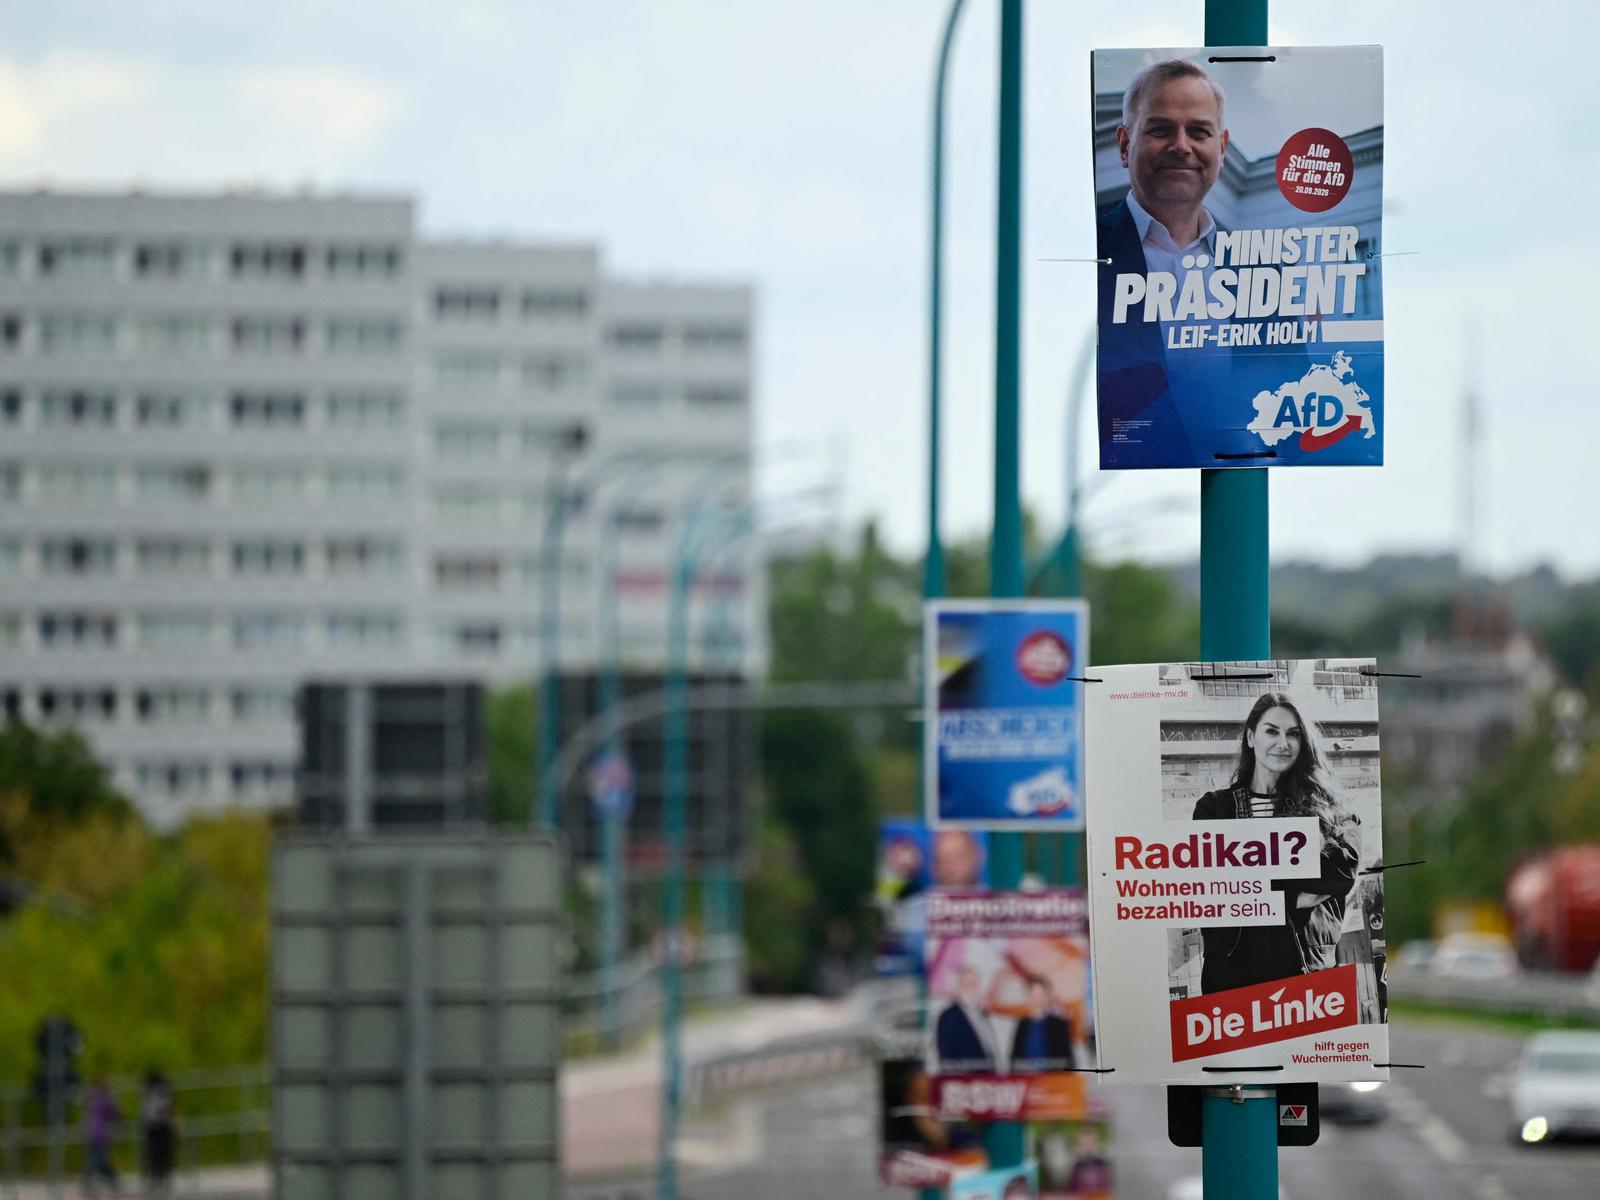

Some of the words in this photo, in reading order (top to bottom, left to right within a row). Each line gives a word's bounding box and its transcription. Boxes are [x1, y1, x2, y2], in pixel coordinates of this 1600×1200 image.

[1307, 143, 1331, 159] Alle
[1288, 154, 1341, 173] Stimmen
[1282, 168, 1301, 183] für
[1303, 169, 1321, 185] die
[1323, 171, 1346, 187] AfD
[1214, 225, 1360, 267] MINISTER
[1112, 253, 1366, 324] PRÄSIDENT
[1167, 322, 1263, 349] LEIF-ERIK
[1266, 320, 1319, 345] HOLM
[1273, 391, 1344, 428] AfD
[1109, 689, 1189, 701] www.dielinke-mv.de
[1114, 830, 1308, 871] Radikal?
[1116, 879, 1206, 898] Wohnen
[1210, 879, 1263, 896] muss
[1117, 900, 1226, 921] bezahlbar
[1230, 898, 1277, 918] sein.
[1186, 1007, 1245, 1046] Die
[1251, 985, 1345, 1033] Linke
[1291, 1052, 1372, 1064] Wuchermieten.
[1314, 1041, 1335, 1052] hilft
[1336, 1042, 1370, 1054] gegen
